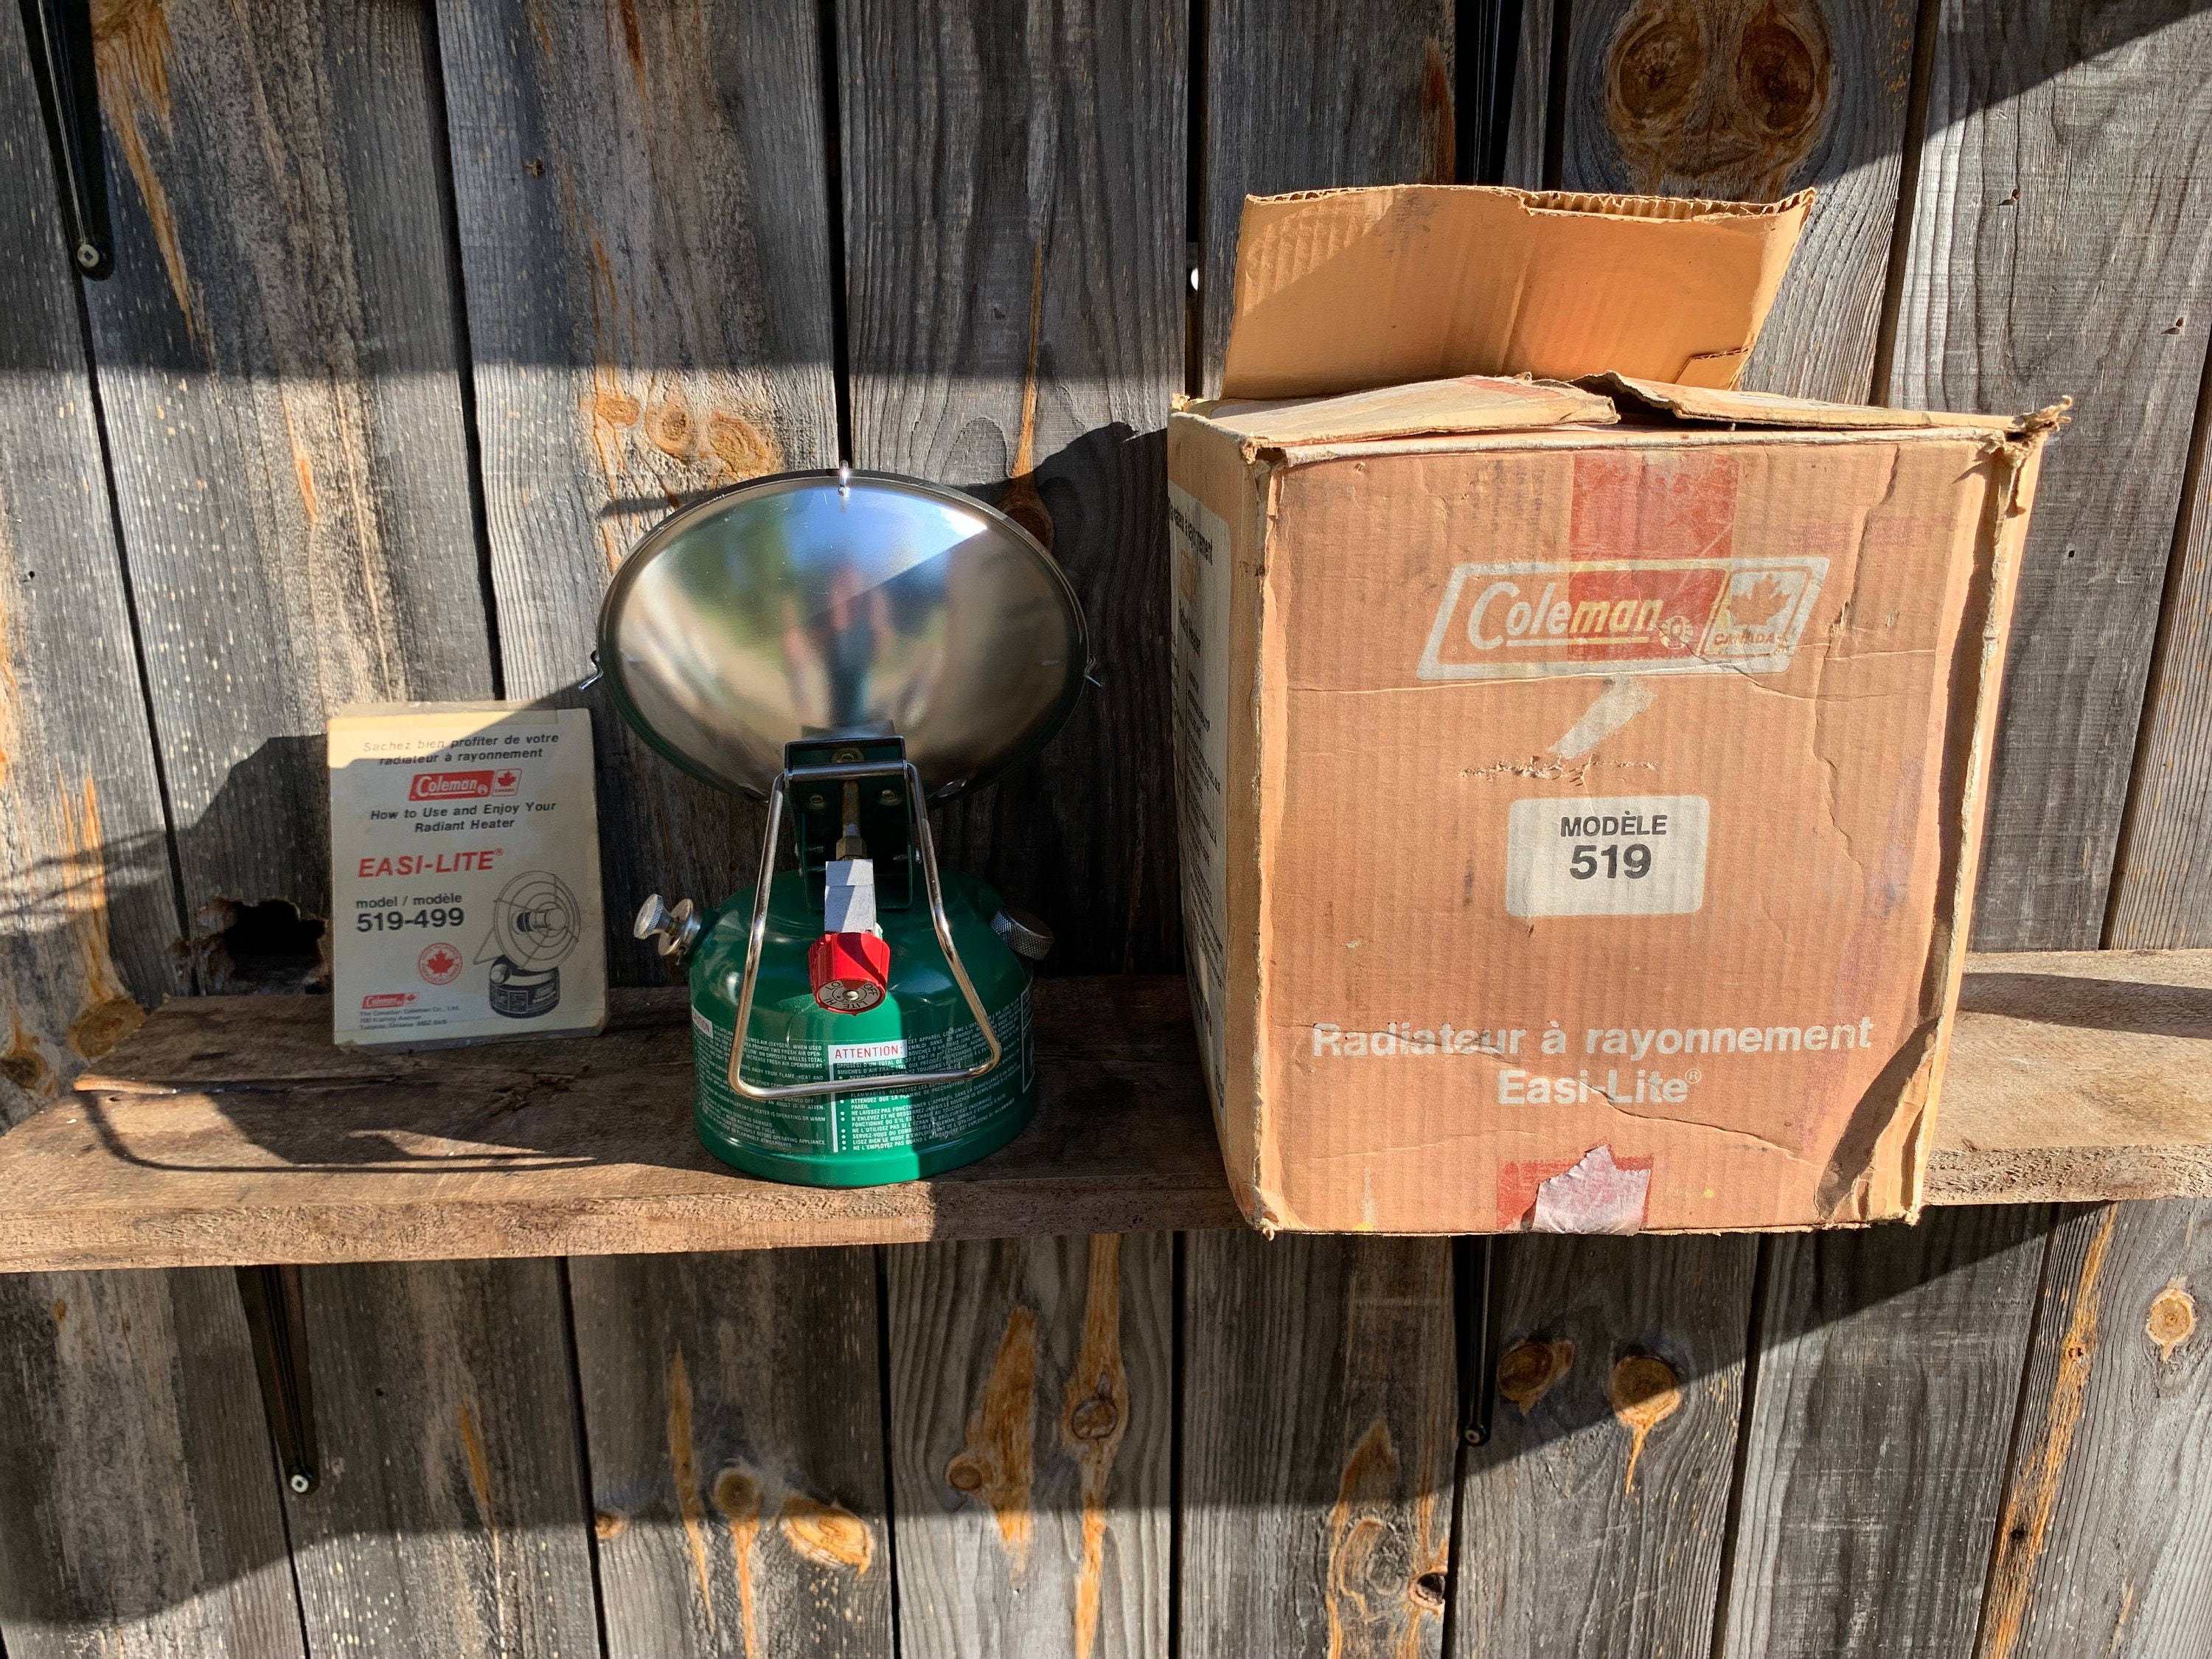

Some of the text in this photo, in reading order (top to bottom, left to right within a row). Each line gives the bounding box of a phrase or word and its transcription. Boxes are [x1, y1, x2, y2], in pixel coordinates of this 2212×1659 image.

[1467, 582, 1663, 650] Coleman
[363, 734, 559, 752] Sachez bien profiter de votre
[379, 748, 543, 765] radiateur à rayonnement
[416, 775, 478, 797] Coleman
[370, 801, 556, 820] How to Use and Enjoy Your
[415, 818, 515, 832] Radiant Heater
[1560, 810, 1668, 838] MODÈLE
[1569, 843, 1652, 880] 519
[356, 897, 397, 908] model
[413, 893, 462, 905] modèle
[357, 908, 465, 932] 519-499
[863, 984, 878, 996] OFF
[919, 1034, 941, 1042] APPAREIL
[1312, 1016, 1875, 1060] Radiateur à rayonnement
[835, 1046, 902, 1059] ATTENTION:
[908, 1048, 931, 1057] BOUCHES
